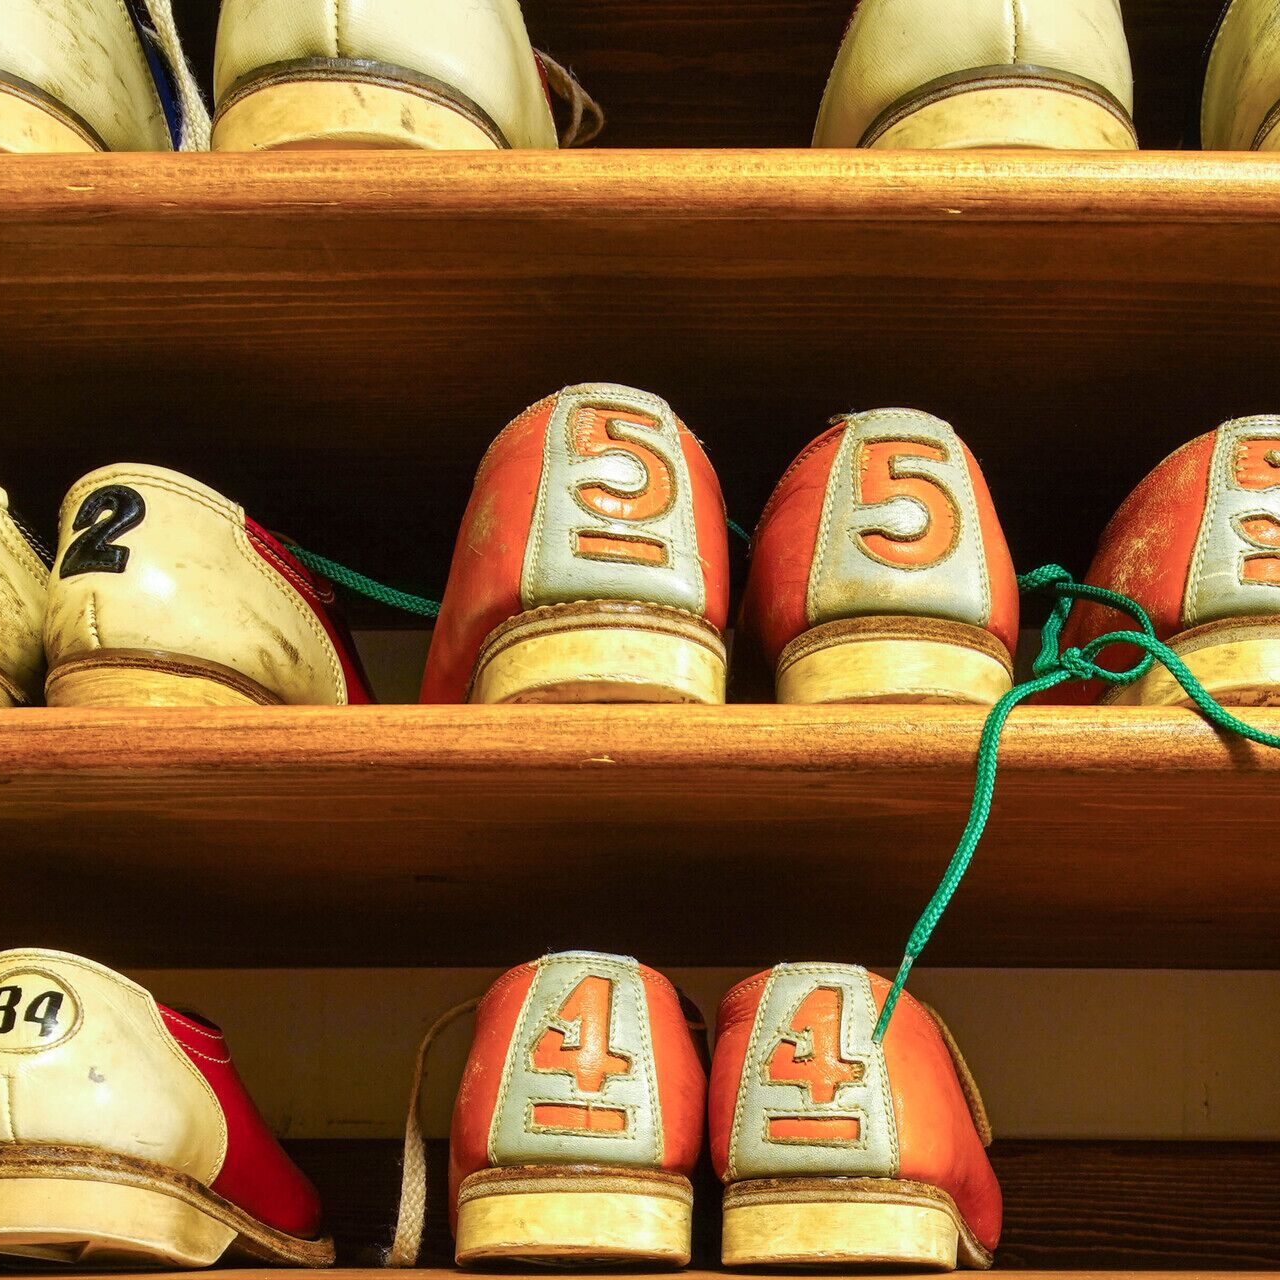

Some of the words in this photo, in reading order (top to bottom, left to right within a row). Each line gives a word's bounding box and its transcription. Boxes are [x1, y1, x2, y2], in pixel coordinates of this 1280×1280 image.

[573, 401, 677, 521] 5
[850, 436, 963, 570] 5
[59, 485, 146, 579] 2
[529, 974, 632, 1092] 4
[763, 985, 865, 1103] 4
